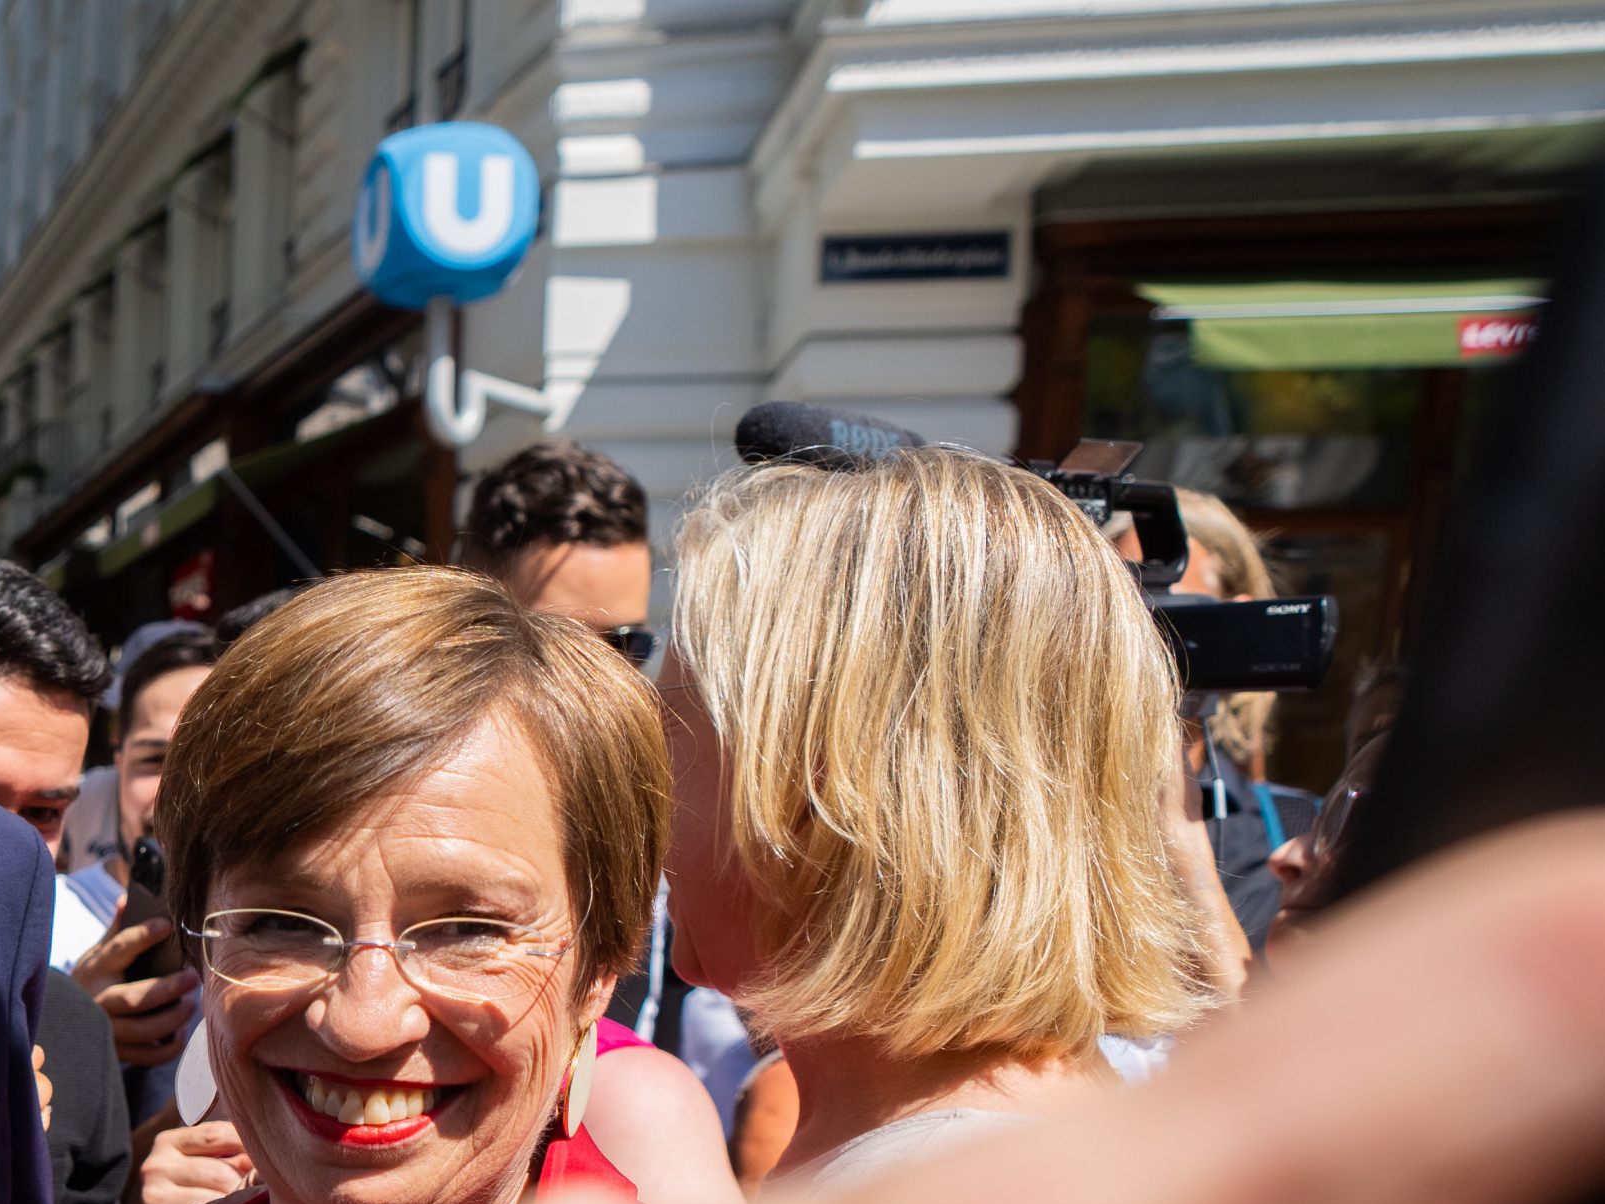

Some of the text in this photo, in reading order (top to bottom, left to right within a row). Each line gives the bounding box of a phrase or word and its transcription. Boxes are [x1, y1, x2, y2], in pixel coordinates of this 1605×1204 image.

[355, 165, 392, 276] U
[423, 152, 515, 256] U
[1266, 603, 1312, 616] SONY
